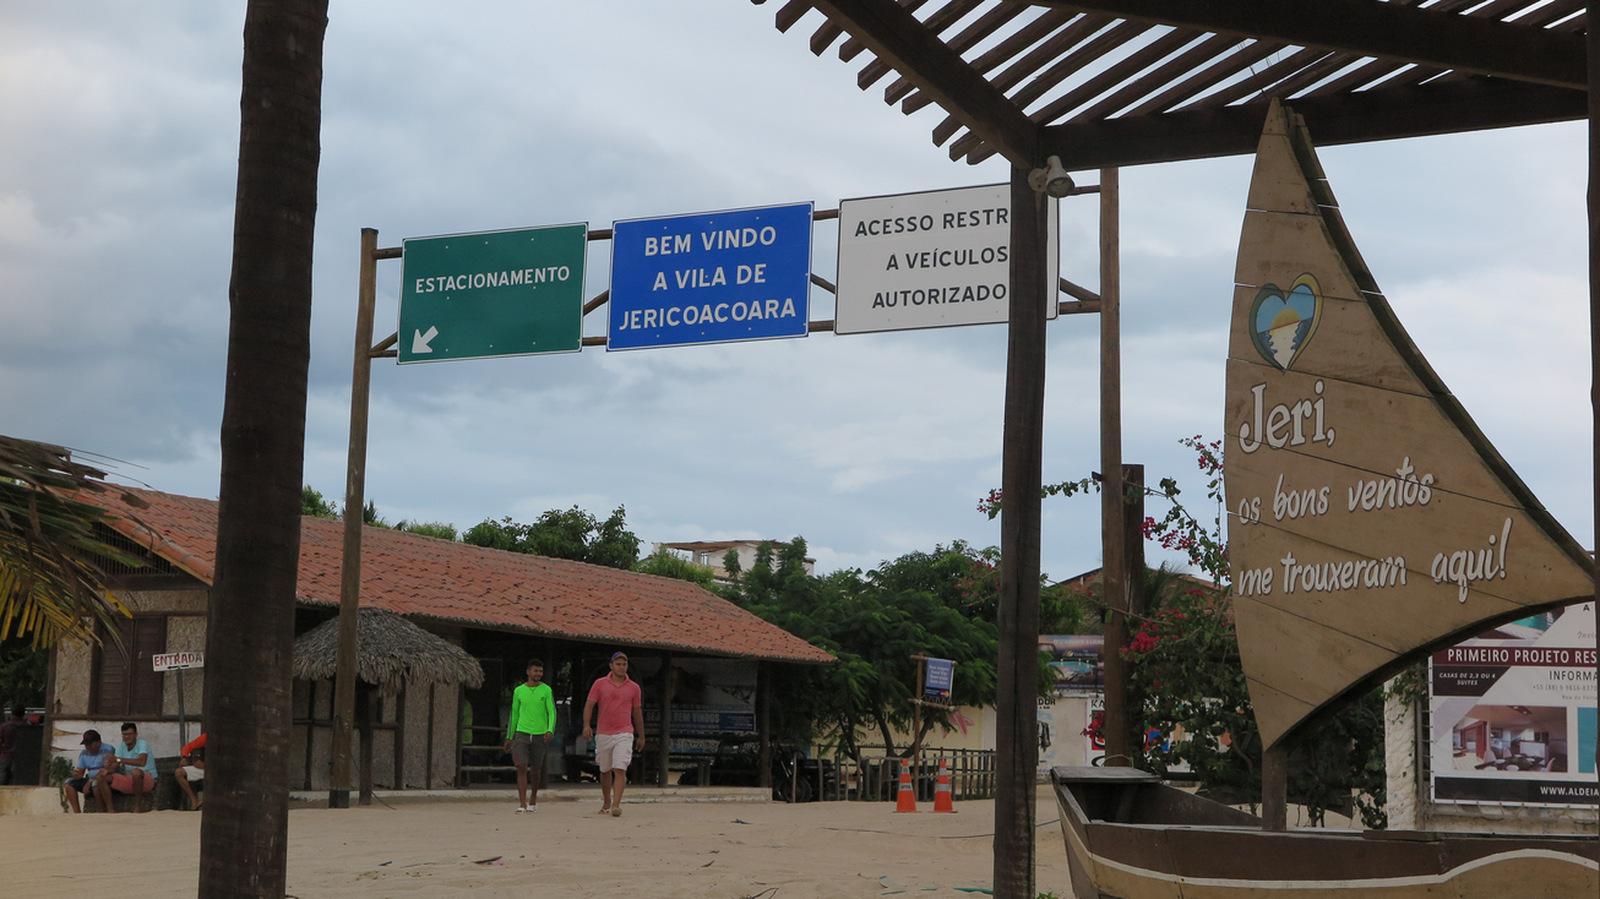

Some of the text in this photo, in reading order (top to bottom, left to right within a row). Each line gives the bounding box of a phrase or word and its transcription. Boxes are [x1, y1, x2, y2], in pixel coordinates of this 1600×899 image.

[855, 208, 1008, 238] ACESSO RESTR
[644, 225, 777, 257] BEM VINDO
[887, 245, 1008, 270] A VEÍCULOS
[415, 265, 571, 294] ESTACIONAMENTO
[653, 263, 767, 291] A VILA DE
[872, 283, 1007, 309] AUTORIZADO
[619, 298, 797, 331] JERICOACOARA
[1238, 379, 1336, 454] Jeri,
[1238, 456, 1435, 525] os bons ventos
[1238, 517, 1513, 604] me trouxeram aqui!
[154, 653, 203, 667] ENTRADA
[1447, 648, 1597, 664] PRIMEIRO PROJETO RES
[1549, 670, 1598, 681] INFORMA
[1540, 785, 1599, 796] WWW.ALDEIA
